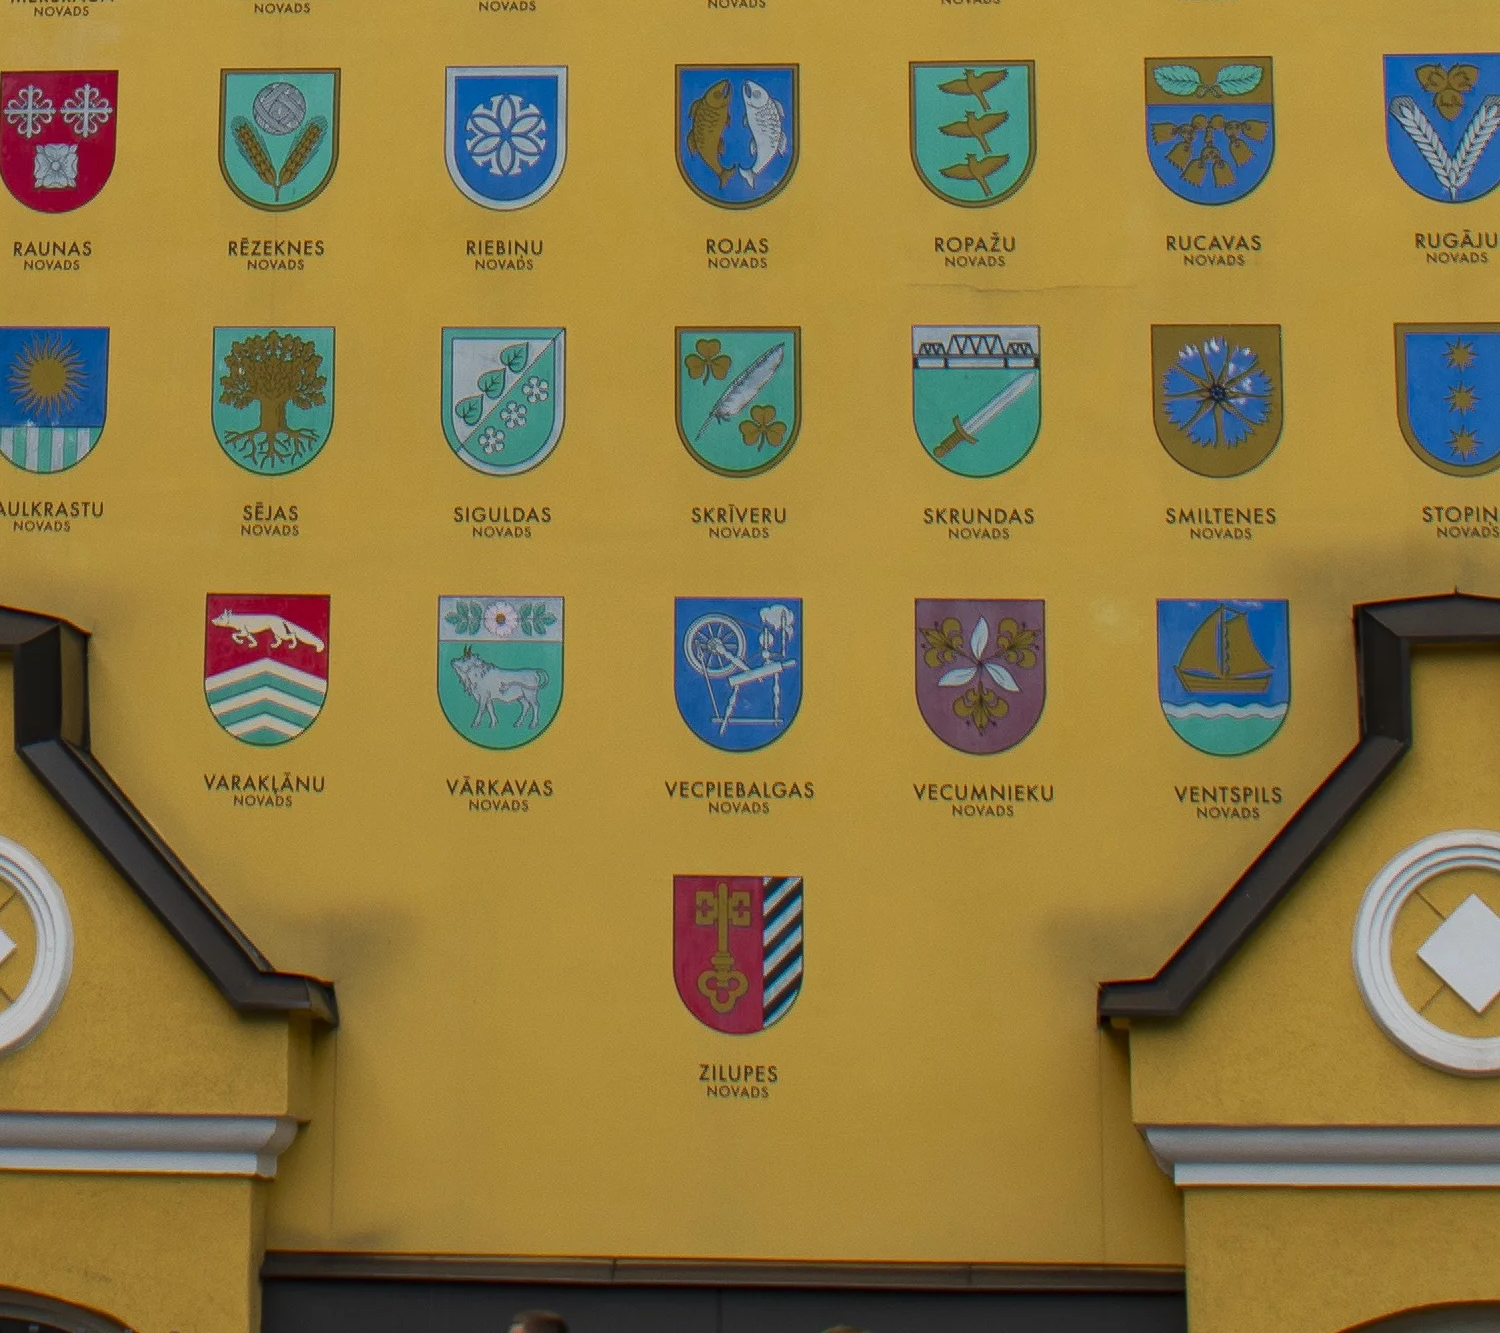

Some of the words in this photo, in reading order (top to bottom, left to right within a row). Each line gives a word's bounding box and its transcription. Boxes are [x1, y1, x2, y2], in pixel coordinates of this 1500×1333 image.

[13, 240, 92, 257] RAUNAS
[228, 237, 325, 257] RĒZEKNES
[706, 237, 770, 255] ROJAS
[934, 231, 1016, 253] ROPAŽU
[1166, 234, 1262, 252] RUCAVAS
[1414, 228, 1498, 249] RUGĀJU
[466, 239, 544, 261] RIEBIŅU
[242, 501, 299, 523] SĒJAS
[453, 505, 552, 524] SIGULDAS
[690, 503, 787, 525] SKRĪVERU
[923, 507, 1035, 525] SKRUNDAS
[1165, 507, 1277, 525] SMILTENES
[203, 771, 325, 798] VARAKĻĀNU
[446, 775, 554, 797] VĀRKAVAS
[664, 780, 815, 799] VECPIEBALGAS
[912, 783, 1054, 803] VECUMNIEKU
[1174, 785, 1282, 805] VENTSPILS
[698, 1063, 778, 1083] ZILUPES
